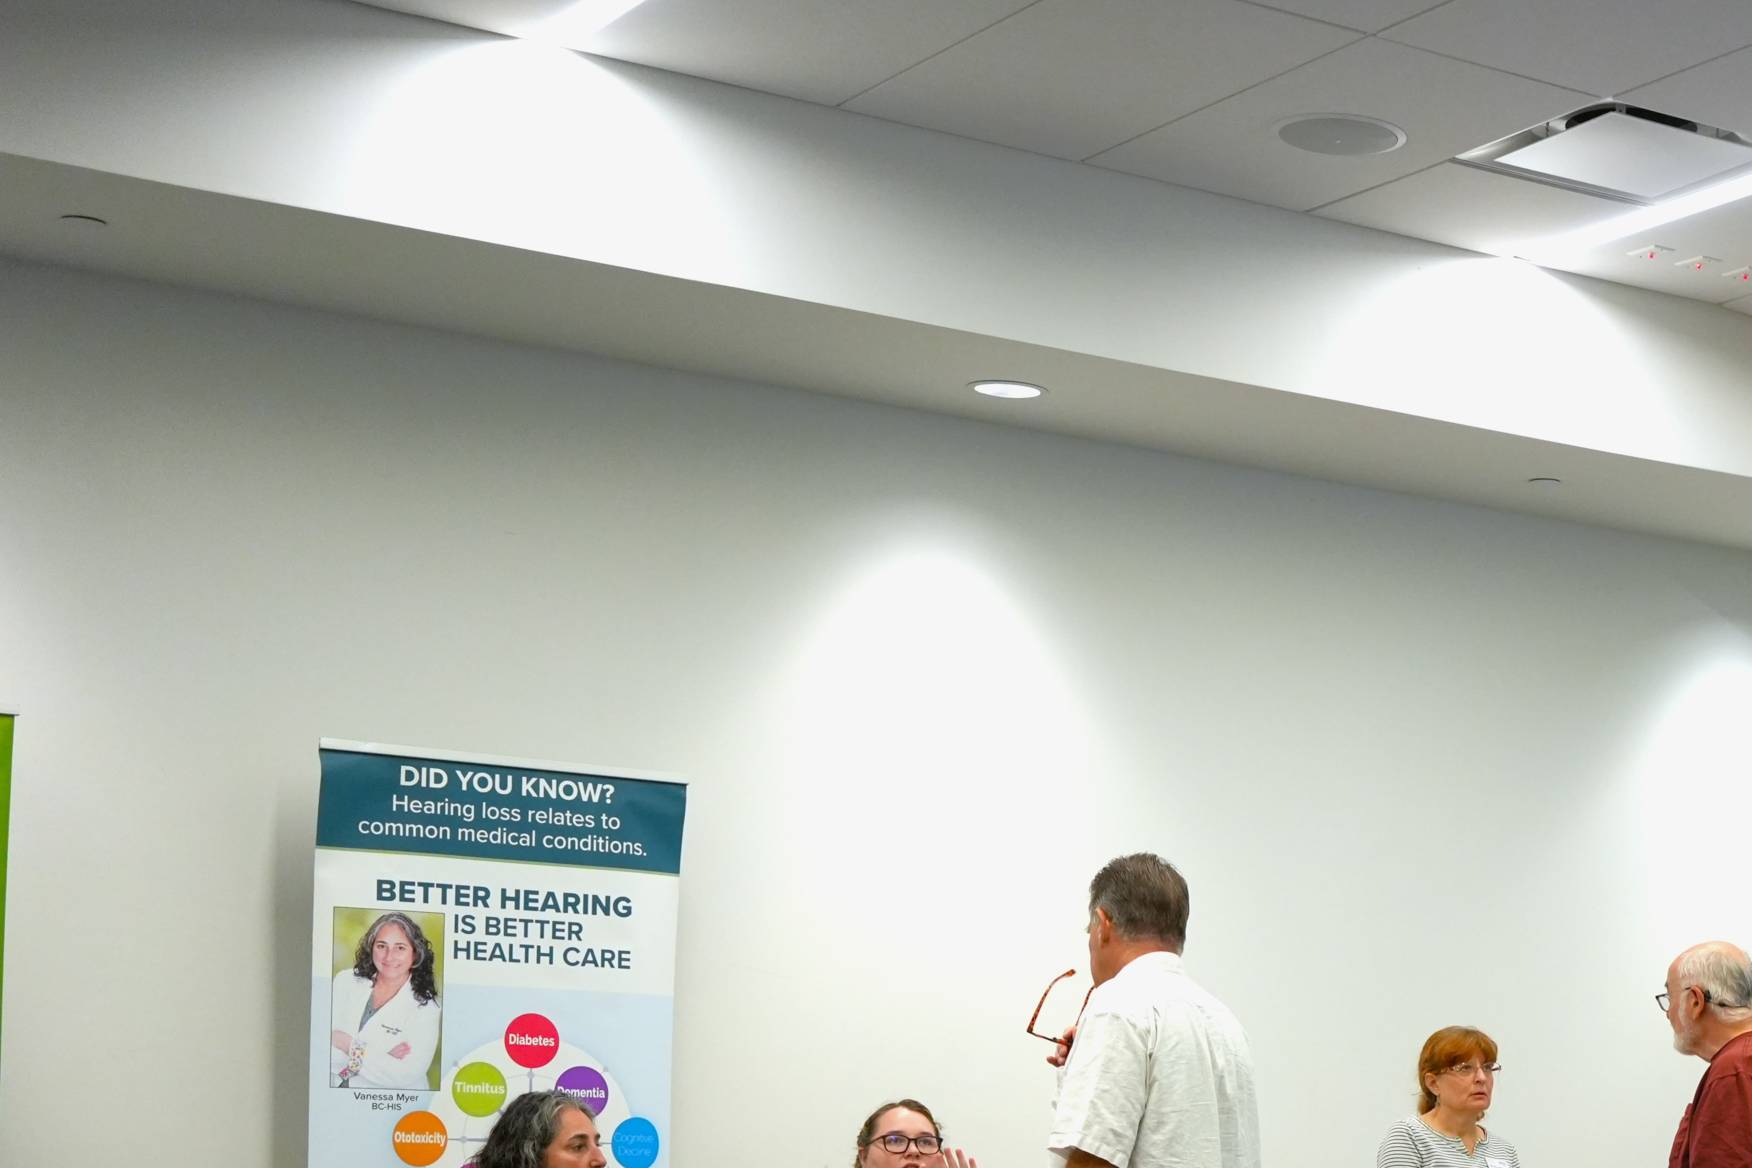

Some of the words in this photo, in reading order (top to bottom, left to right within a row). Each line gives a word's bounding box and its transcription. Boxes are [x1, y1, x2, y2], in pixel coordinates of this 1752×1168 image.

[400, 765, 448, 788] DID
[455, 770, 513, 795] YOU
[521, 777, 615, 804] KNOW?
[392, 794, 475, 822] Hearing
[482, 802, 521, 822] loss
[528, 808, 595, 828] relates
[601, 813, 620, 830] to
[358, 820, 451, 840] common
[457, 825, 536, 847] medical
[542, 832, 647, 857] conditions.
[376, 879, 491, 908] BETTER
[500, 888, 633, 918] HEARING
[454, 914, 476, 935] IS
[485, 916, 583, 941] BETTER
[453, 940, 554, 965] HEALTH
[562, 946, 632, 970] CARE
[508, 1033, 555, 1048] Diabetes
[353, 1091, 394, 1102] Vanessa
[396, 1093, 419, 1104] Myer
[454, 1081, 505, 1096] Tinnitus
[371, 1102, 402, 1111] BC-HIS
[394, 1131, 447, 1145] Ototoxicity
